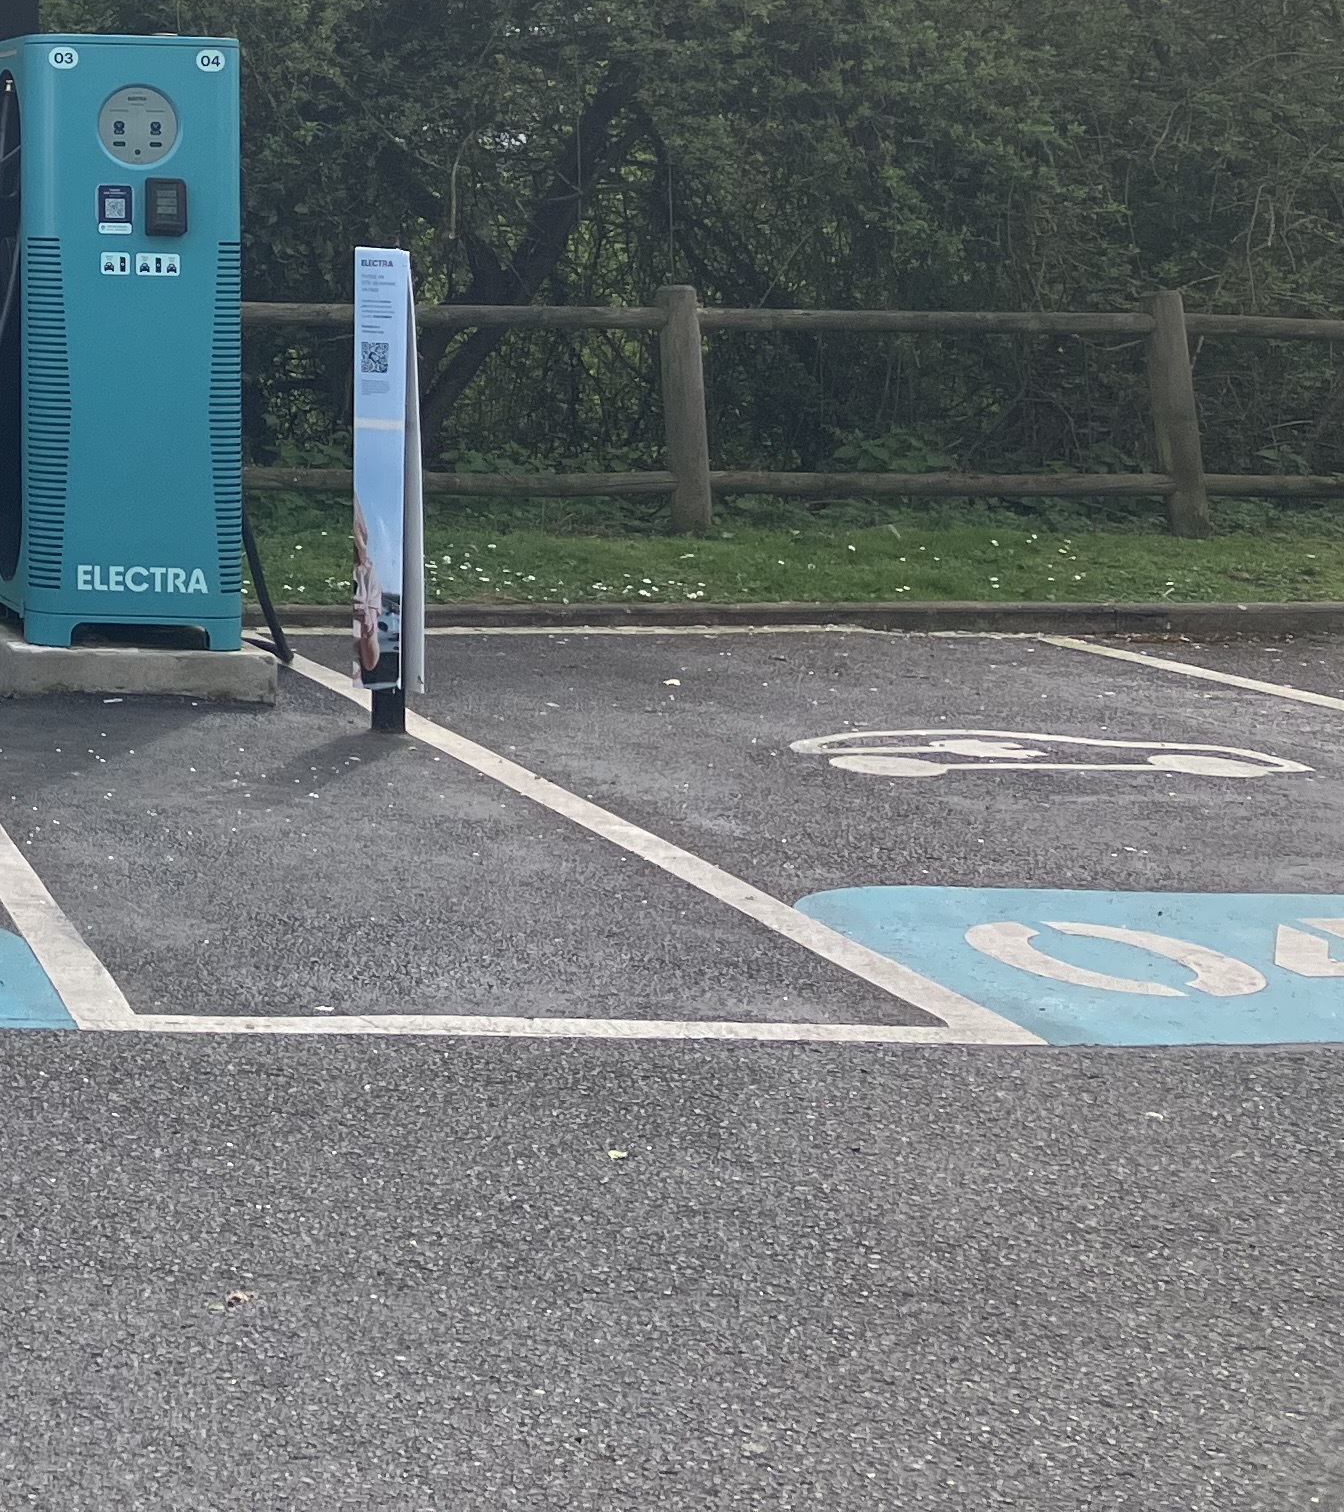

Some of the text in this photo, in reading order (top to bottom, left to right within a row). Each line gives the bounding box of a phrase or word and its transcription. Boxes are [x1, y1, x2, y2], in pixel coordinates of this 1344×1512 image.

[53, 51, 74, 65] 03
[200, 54, 221, 68] 04
[361, 259, 394, 267] ELECTRA
[76, 564, 209, 595] ELECTRA
[964, 918, 1344, 996] 0
